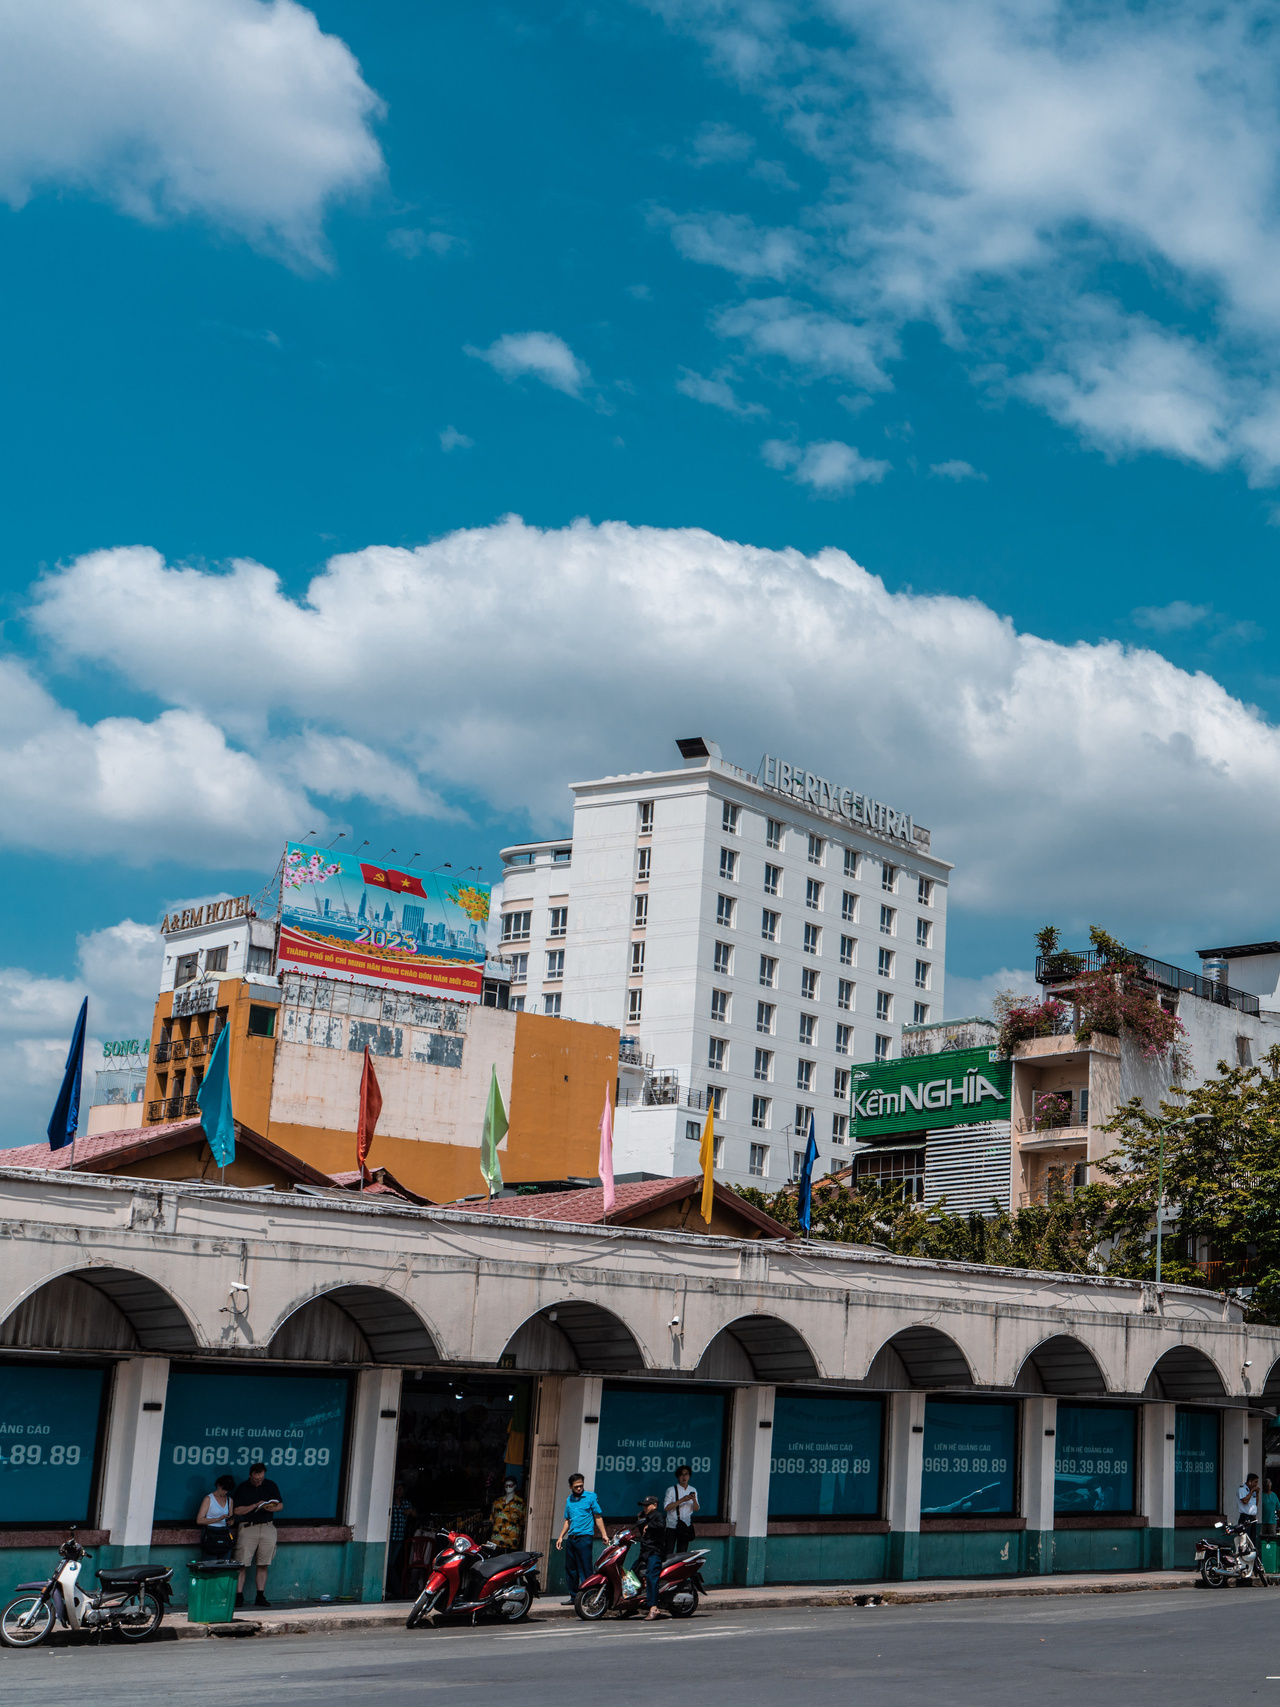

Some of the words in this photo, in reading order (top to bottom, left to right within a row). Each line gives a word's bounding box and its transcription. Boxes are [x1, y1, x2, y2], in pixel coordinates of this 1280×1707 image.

[160, 908, 203, 934] A&EM
[206, 894, 253, 924] HOTEL
[354, 924, 419, 954] 2023
[286, 947, 309, 957] THÀNH
[309, 952, 324, 960] PHỐ
[324, 954, 334, 962] HỒ
[335, 956, 347, 965] CHÍ
[347, 959, 366, 968] MINH
[366, 962, 380, 971] HÂN
[381, 966, 399, 975] HOAN
[400, 969, 418, 978] CHÀO
[418, 972, 432, 980] ĐÓN
[433, 975, 448, 983] NĂM
[449, 977, 462, 985] MỚI
[462, 980, 478, 988] 2023
[103, 1040, 141, 1057] SONG
[0, 1422, 23, 1434] ẢNG
[27, 1424, 50, 1435] CÁO
[205, 1427, 228, 1437] LIÊN
[231, 1427, 245, 1438] HỆ
[247, 1427, 281, 1438] QUẢNG
[284, 1428, 304, 1438] CÁO
[617, 1439, 635, 1448] LIÊN
[636, 1439, 647, 1449] HỆ
[649, 1439, 674, 1448] QUẢNG
[676, 1440, 691, 1448] CÁO
[788, 1443, 804, 1451] LIÊN
[805, 1443, 814, 1452] HỆ
[815, 1442, 838, 1451] QUẢNG
[839, 1444, 853, 1452] CÁO
[934, 1443, 948, 1451] LIÊN
[979, 1444, 991, 1452] CÁO
[0, 1445, 81, 1466] .89.89
[172, 1446, 331, 1466] 0969.39.89.89
[596, 1455, 712, 1473] 0969.39.8989
[923, 1457, 1007, 1473] 969.39.89.89
[1055, 1459, 1128, 1474] 969.39.89.89
